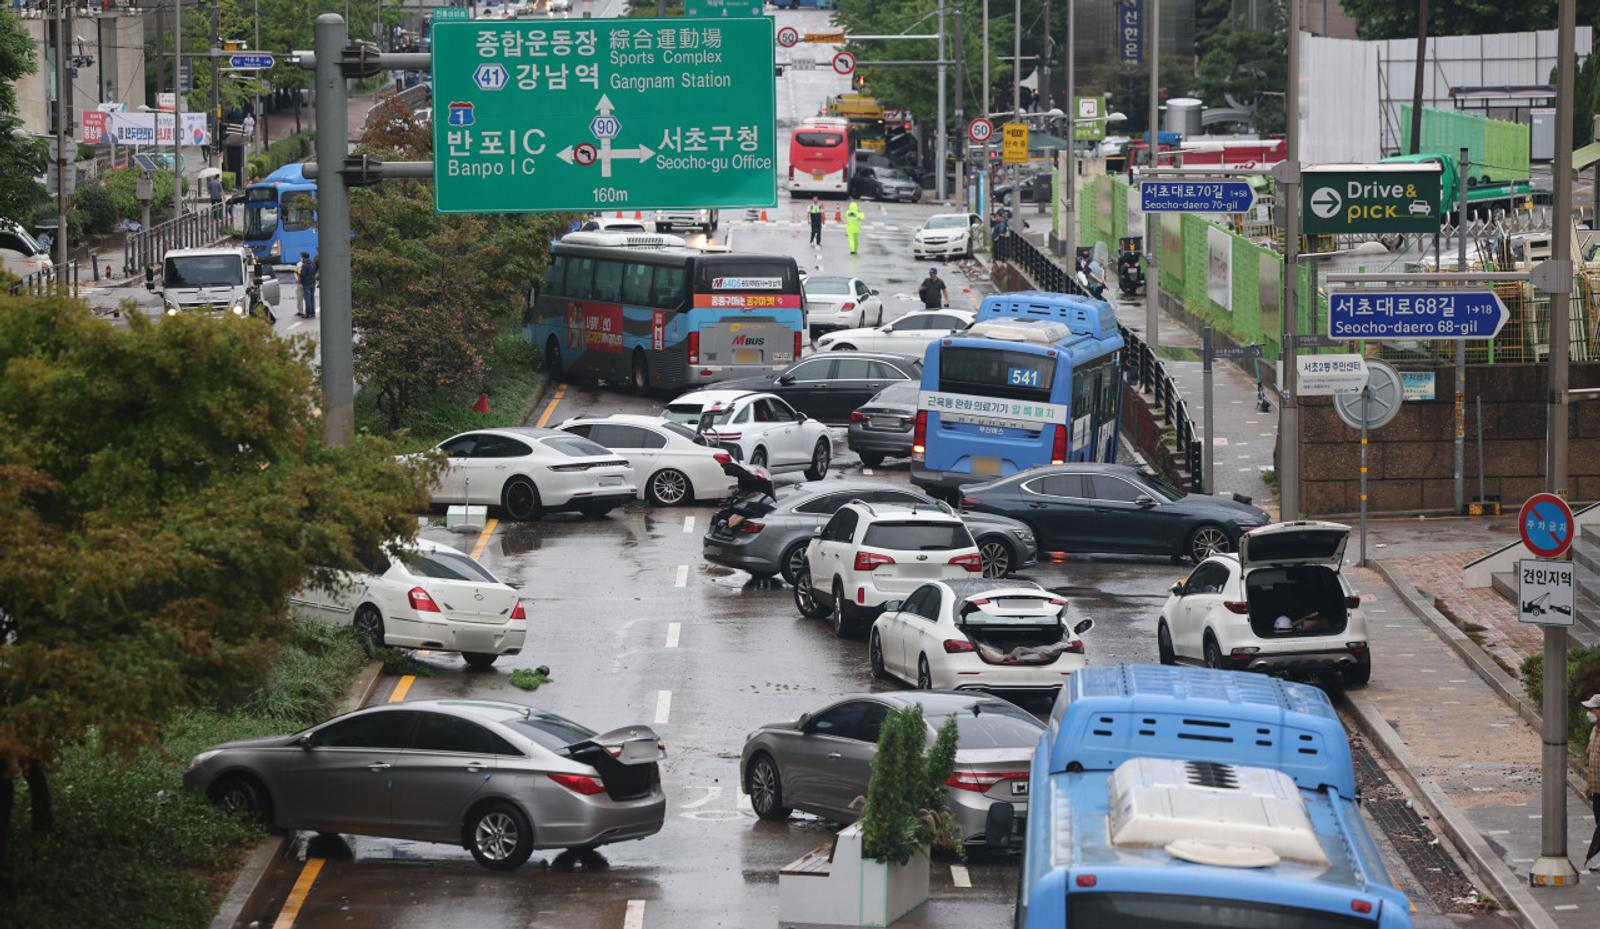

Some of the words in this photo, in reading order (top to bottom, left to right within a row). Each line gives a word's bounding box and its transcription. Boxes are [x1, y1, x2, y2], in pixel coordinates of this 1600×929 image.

[476, 29, 598, 58] 종합운동장
[609, 27, 722, 49] 綜合運動場
[781, 33, 795, 42] 50
[610, 50, 654, 66] Sports
[663, 49, 722, 66] Complex
[481, 68, 502, 85] 41
[516, 63, 599, 90] 강남역
[610, 73, 675, 93] Gangnam
[681, 72, 731, 89] Station
[455, 109, 465, 124] 1
[597, 119, 615, 135] 90
[973, 124, 988, 135] 50
[657, 125, 759, 152] 서초구청
[447, 159, 504, 178] Banpo
[656, 155, 728, 173] Seocho-gu
[731, 155, 772, 170] Office
[592, 188, 628, 202] 160m
[1144, 184, 1224, 199] 서초대로70길
[1144, 200, 1210, 209] Seocho-daero
[1212, 200, 1238, 211] 70-gil
[1335, 297, 1455, 317] 서초대로68길
[1335, 320, 1434, 334] Seocho-daero
[1437, 320, 1478, 335] 68-gil
[1304, 361, 1331, 373] 서초2동
[1332, 361, 1361, 372] 주민센터
[1012, 369, 1038, 385] 541
[955, 398, 973, 410] 완화
[973, 401, 1009, 414] 의료기기
[1527, 520, 1567, 532] 주차금지
[1523, 569, 1572, 587] 견인지역
